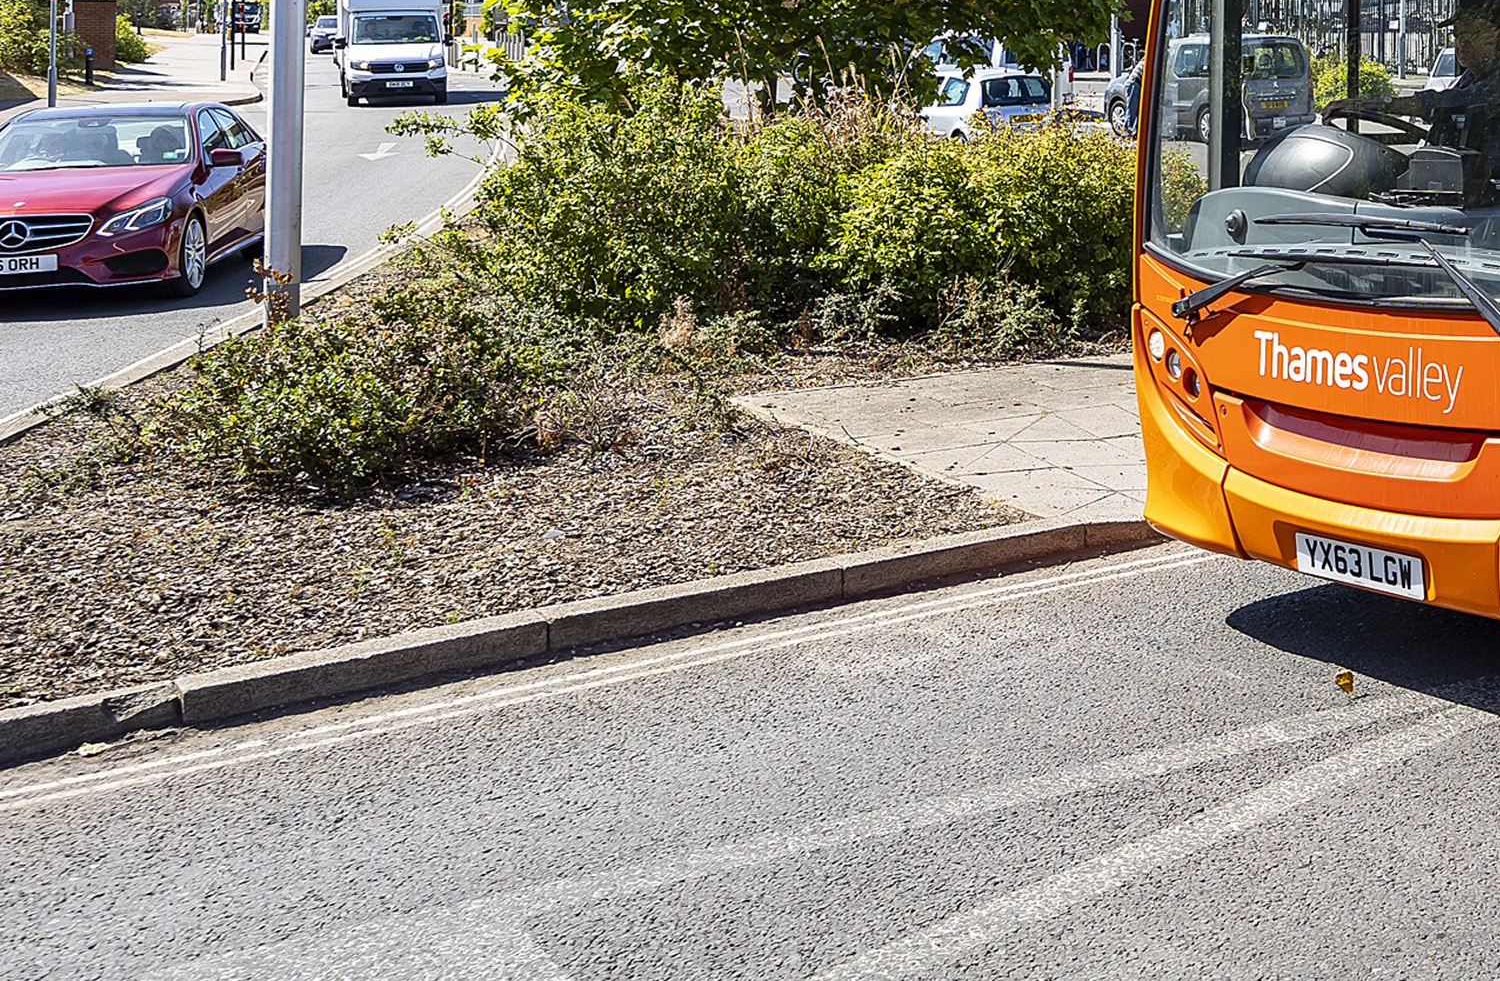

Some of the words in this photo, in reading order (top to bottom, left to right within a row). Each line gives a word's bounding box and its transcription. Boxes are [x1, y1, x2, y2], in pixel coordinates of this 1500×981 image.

[8, 257, 39, 271] ORH
[1254, 330, 1369, 391] Thames
[1372, 346, 1464, 414] valley
[1305, 538, 1363, 578] YX63
[1368, 551, 1412, 590] LGW
